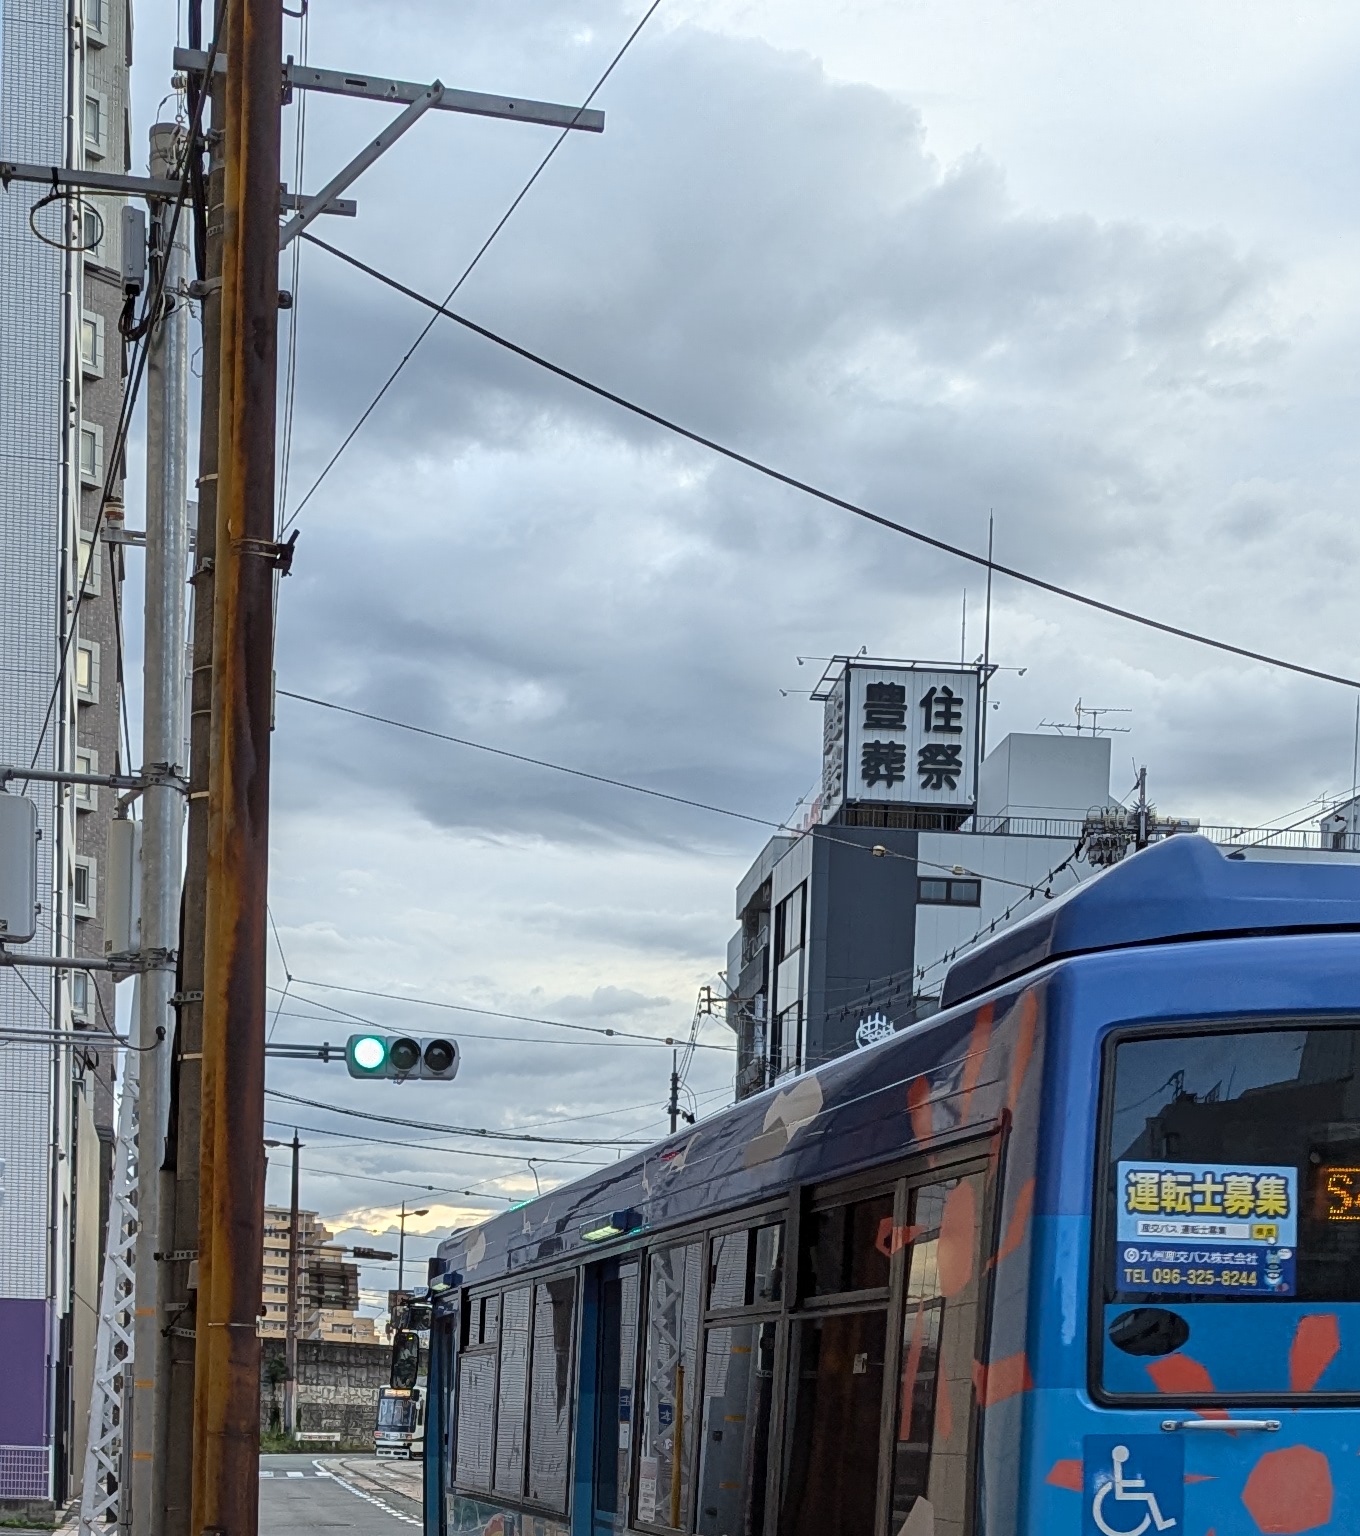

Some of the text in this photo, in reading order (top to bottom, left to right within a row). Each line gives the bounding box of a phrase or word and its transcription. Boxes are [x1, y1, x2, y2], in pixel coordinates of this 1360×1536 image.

[860, 740, 964, 790] 葬祭
[1126, 1171, 1289, 1217] 運転士募集
[1123, 1268, 1258, 1287] TEL 096-325-8244
